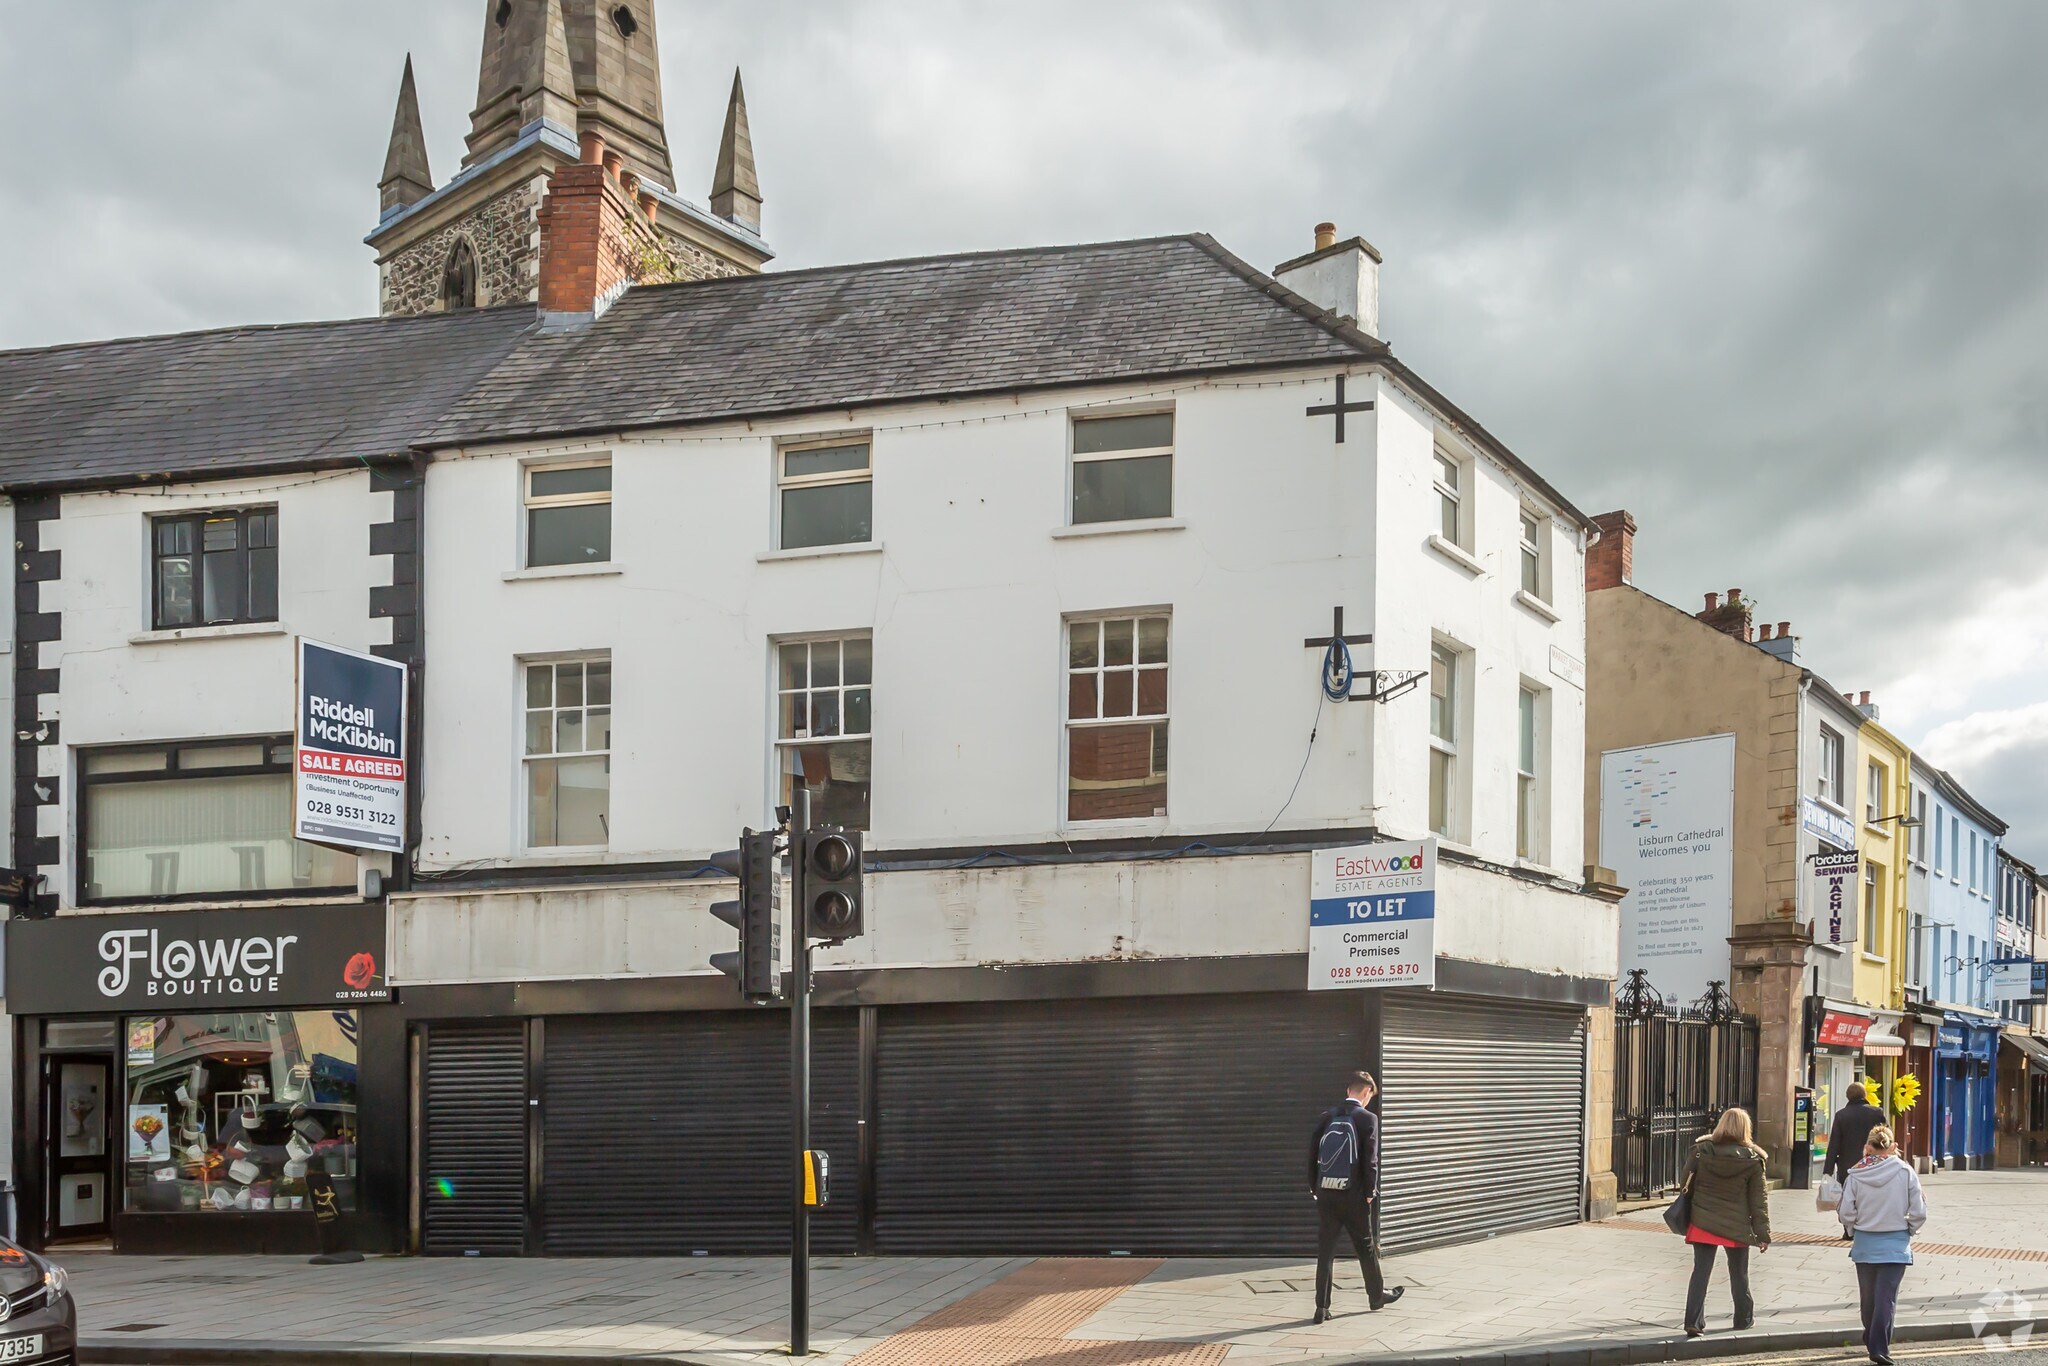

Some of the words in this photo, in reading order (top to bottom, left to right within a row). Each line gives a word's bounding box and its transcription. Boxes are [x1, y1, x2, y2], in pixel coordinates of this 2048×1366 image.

[310, 695, 374, 728] Riddell
[310, 717, 395, 754] McKibbin
[302, 754, 341, 771] SALE
[344, 759, 402, 777] AGREED
[306, 784, 336, 795] (Business
[337, 789, 374, 802] Unaffected)
[352, 780, 399, 796] Opportunity
[307, 800, 331, 815] 028
[336, 805, 364, 820] 9531
[368, 811, 396, 825] 3122
[1638, 835, 1673, 846] Lisburn
[1677, 827, 1723, 842] Cathedral
[1639, 845, 1688, 858] Welcomes
[1692, 843, 1711, 855] you
[1336, 845, 1423, 877] Eastwood
[1815, 853, 1857, 865] brother
[1815, 865, 1858, 876] SEWING
[1335, 880, 1373, 892] ESTATE
[1378, 876, 1423, 889] AGENTS
[1638, 877, 1677, 887] Celebrating
[1680, 877, 1693, 885] 350
[1695, 873, 1714, 883] years
[1655, 885, 1688, 896] Cathedral
[1347, 900, 1371, 919] TO
[1377, 898, 1406, 917] LET
[1829, 876, 1843, 942] MACHINES
[1343, 929, 1408, 943] Commercial
[1349, 946, 1400, 957] Premises
[97, 928, 298, 997] Flower
[1331, 967, 1351, 978] 028
[1356, 965, 1384, 976] 9266
[1389, 963, 1419, 975] 5870
[147, 976, 278, 996] BOUTIQUE
[1797, 1099, 1805, 1110] P
[1321, 1176, 1349, 1190] NIKE
